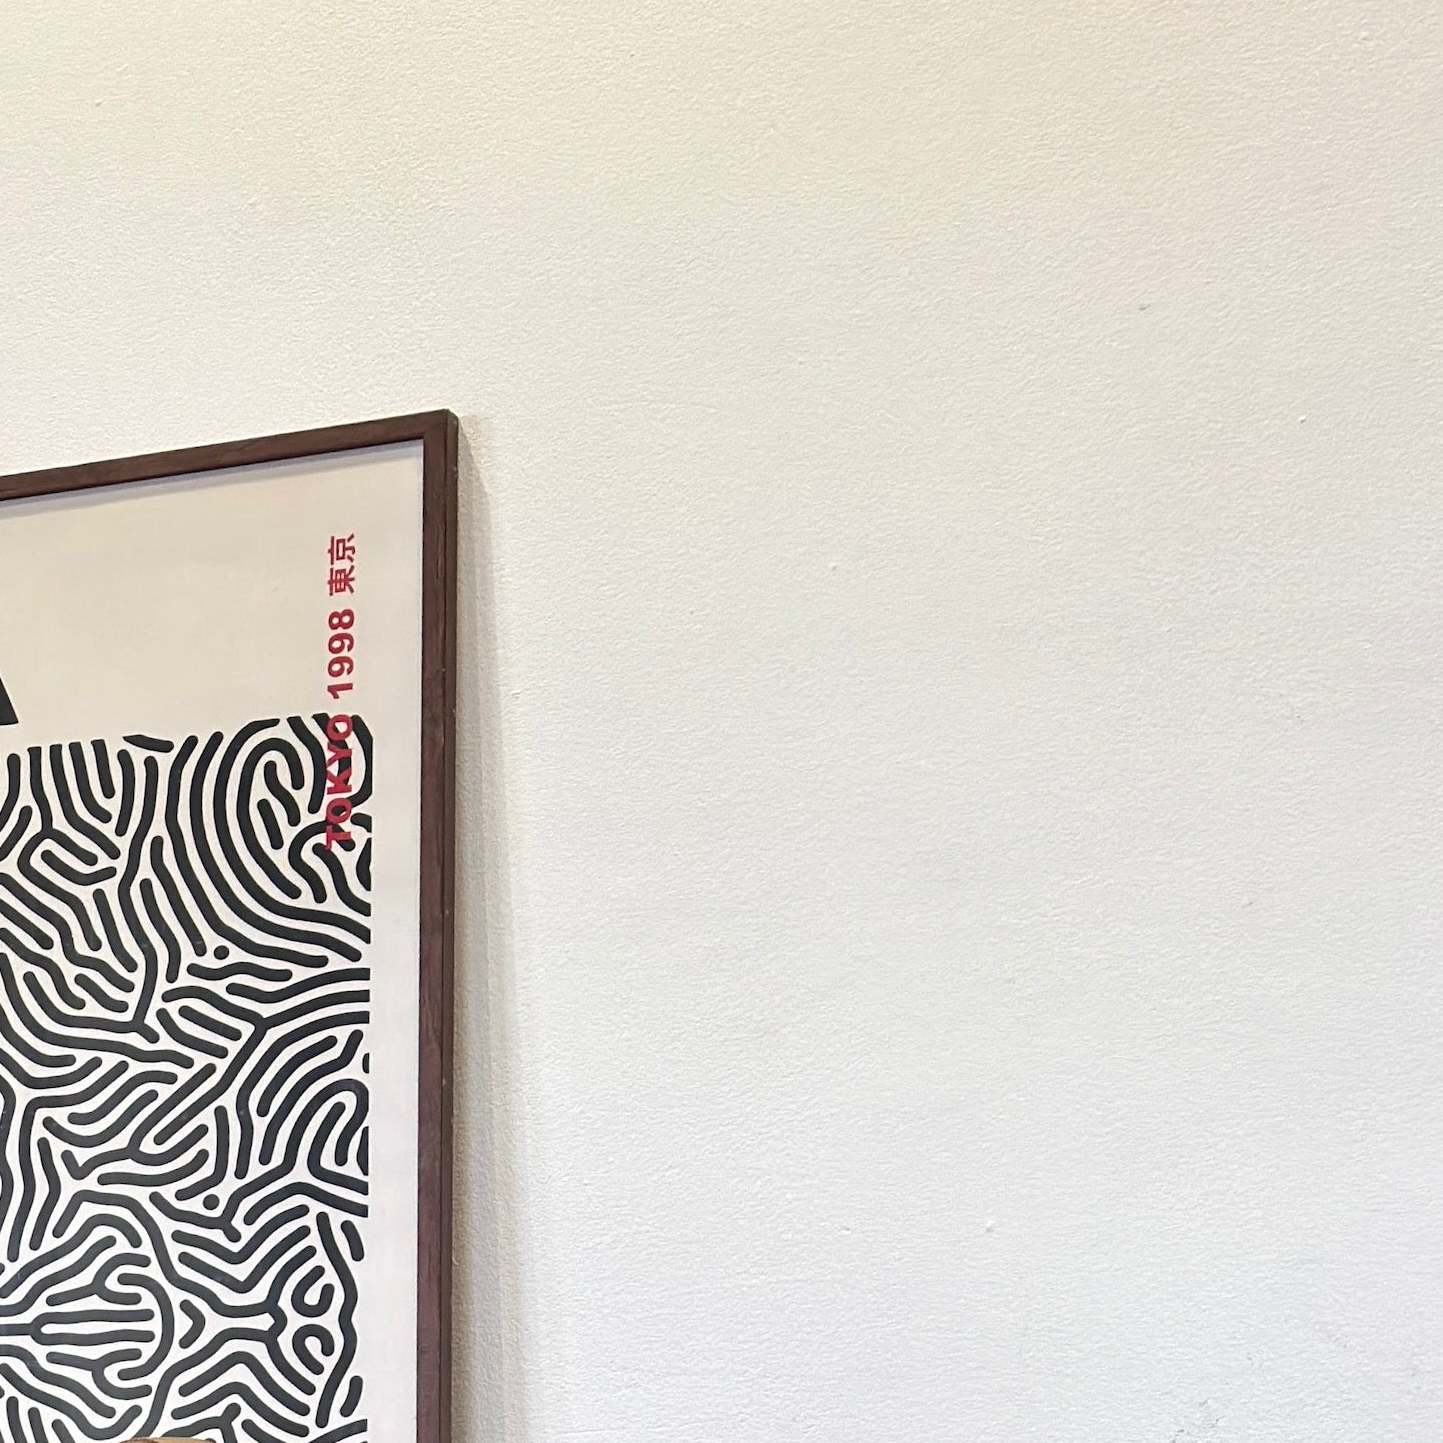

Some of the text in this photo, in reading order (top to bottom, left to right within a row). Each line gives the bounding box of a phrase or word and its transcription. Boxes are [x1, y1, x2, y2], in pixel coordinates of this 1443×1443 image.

[325, 533, 356, 852] TOKYO 1998 東京
